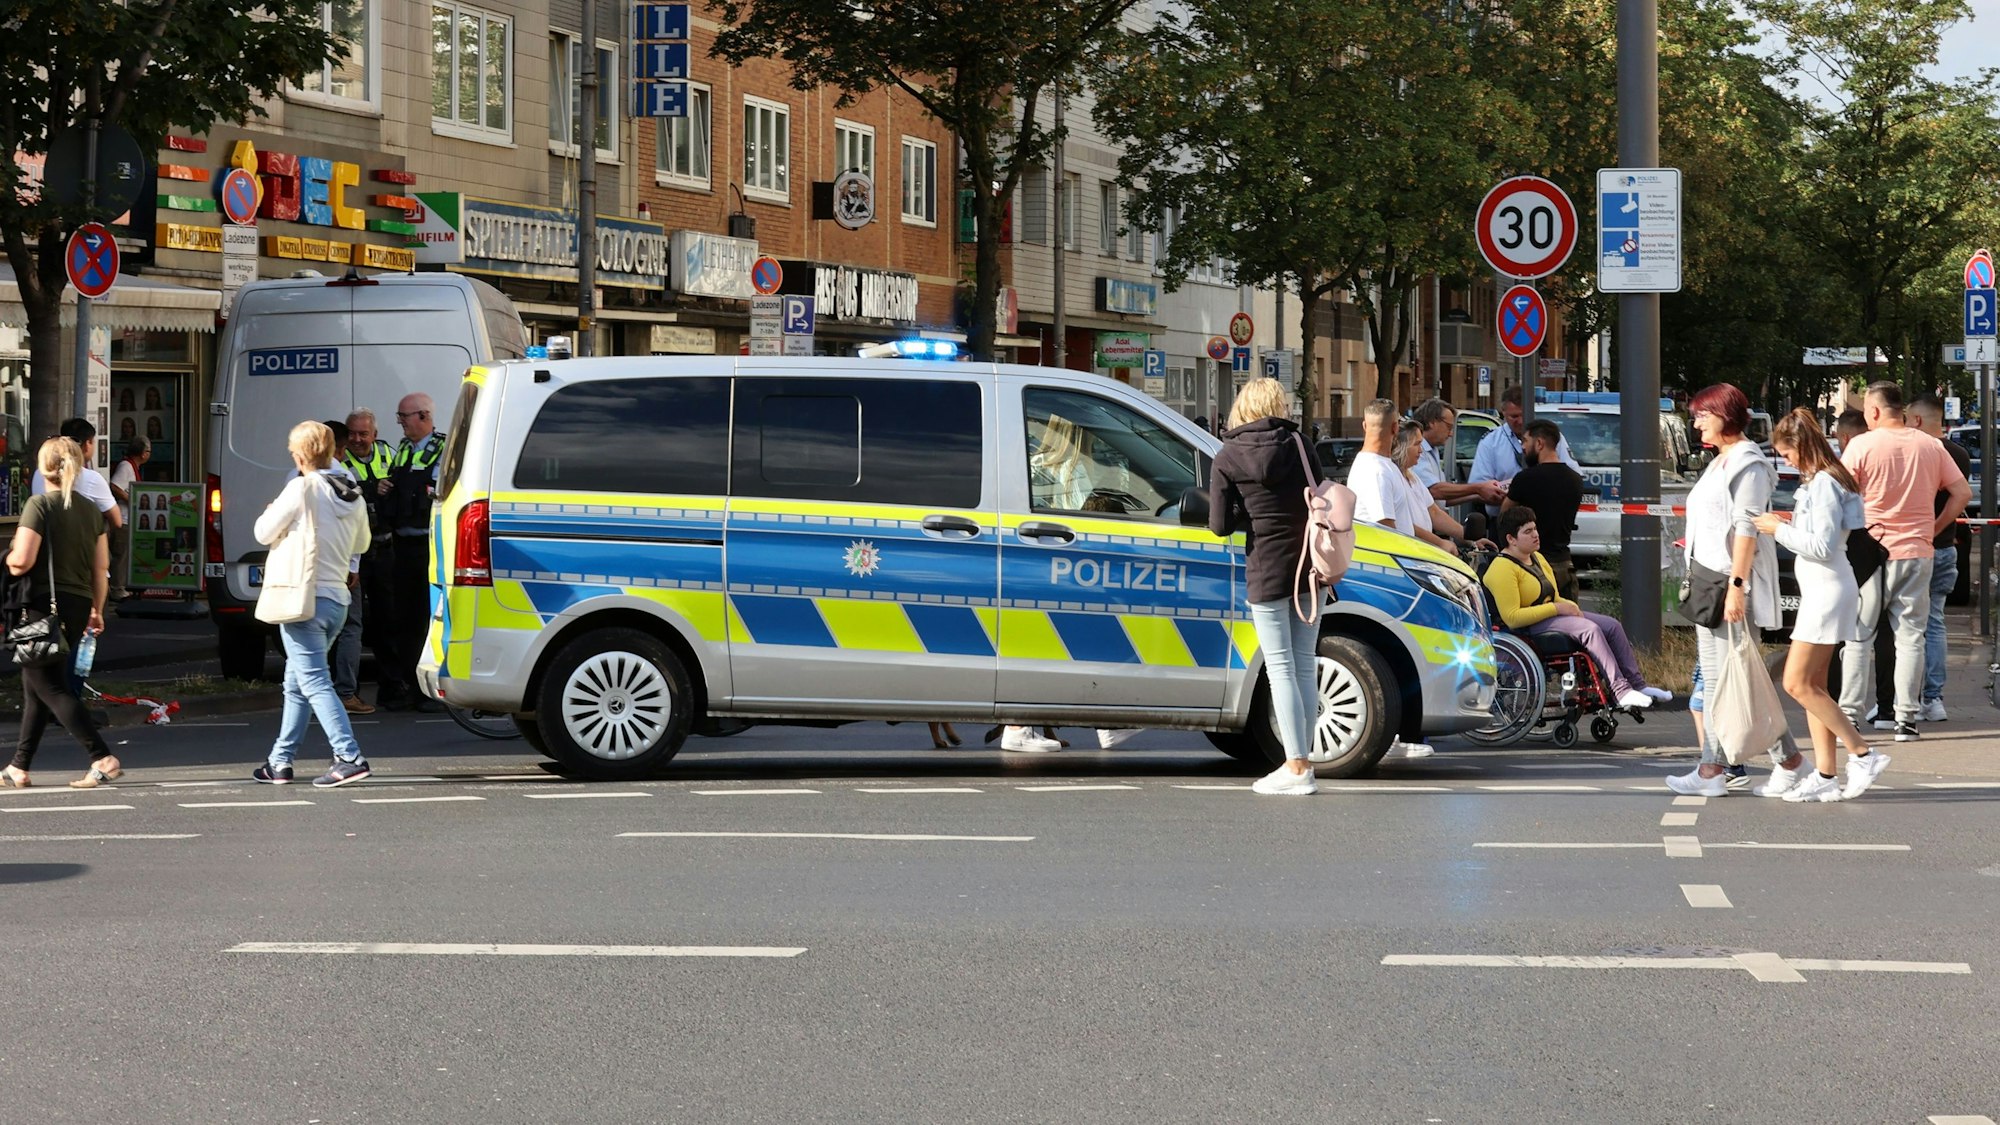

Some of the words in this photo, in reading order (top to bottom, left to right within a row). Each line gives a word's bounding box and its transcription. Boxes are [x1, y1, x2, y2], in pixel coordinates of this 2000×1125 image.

[1498, 206, 1554, 249] 30
[224, 232, 256, 245] Ladezone
[465, 210, 578, 267] SPIELHALLE
[596, 226, 668, 276] OLOGNE
[228, 264, 254, 273] werktags
[752, 301, 780, 309] Ladezone
[861, 272, 918, 321] BARBERSHOP
[788, 300, 806, 329] P
[1969, 295, 1987, 330] P
[252, 352, 336, 371] POLIZEI
[1147, 353, 1159, 374] P
[1480, 368, 1487, 382] P
[1583, 474, 1621, 486] POLIZ
[1050, 557, 1187, 592] POLIZEI
[1781, 597, 1800, 607] 323
